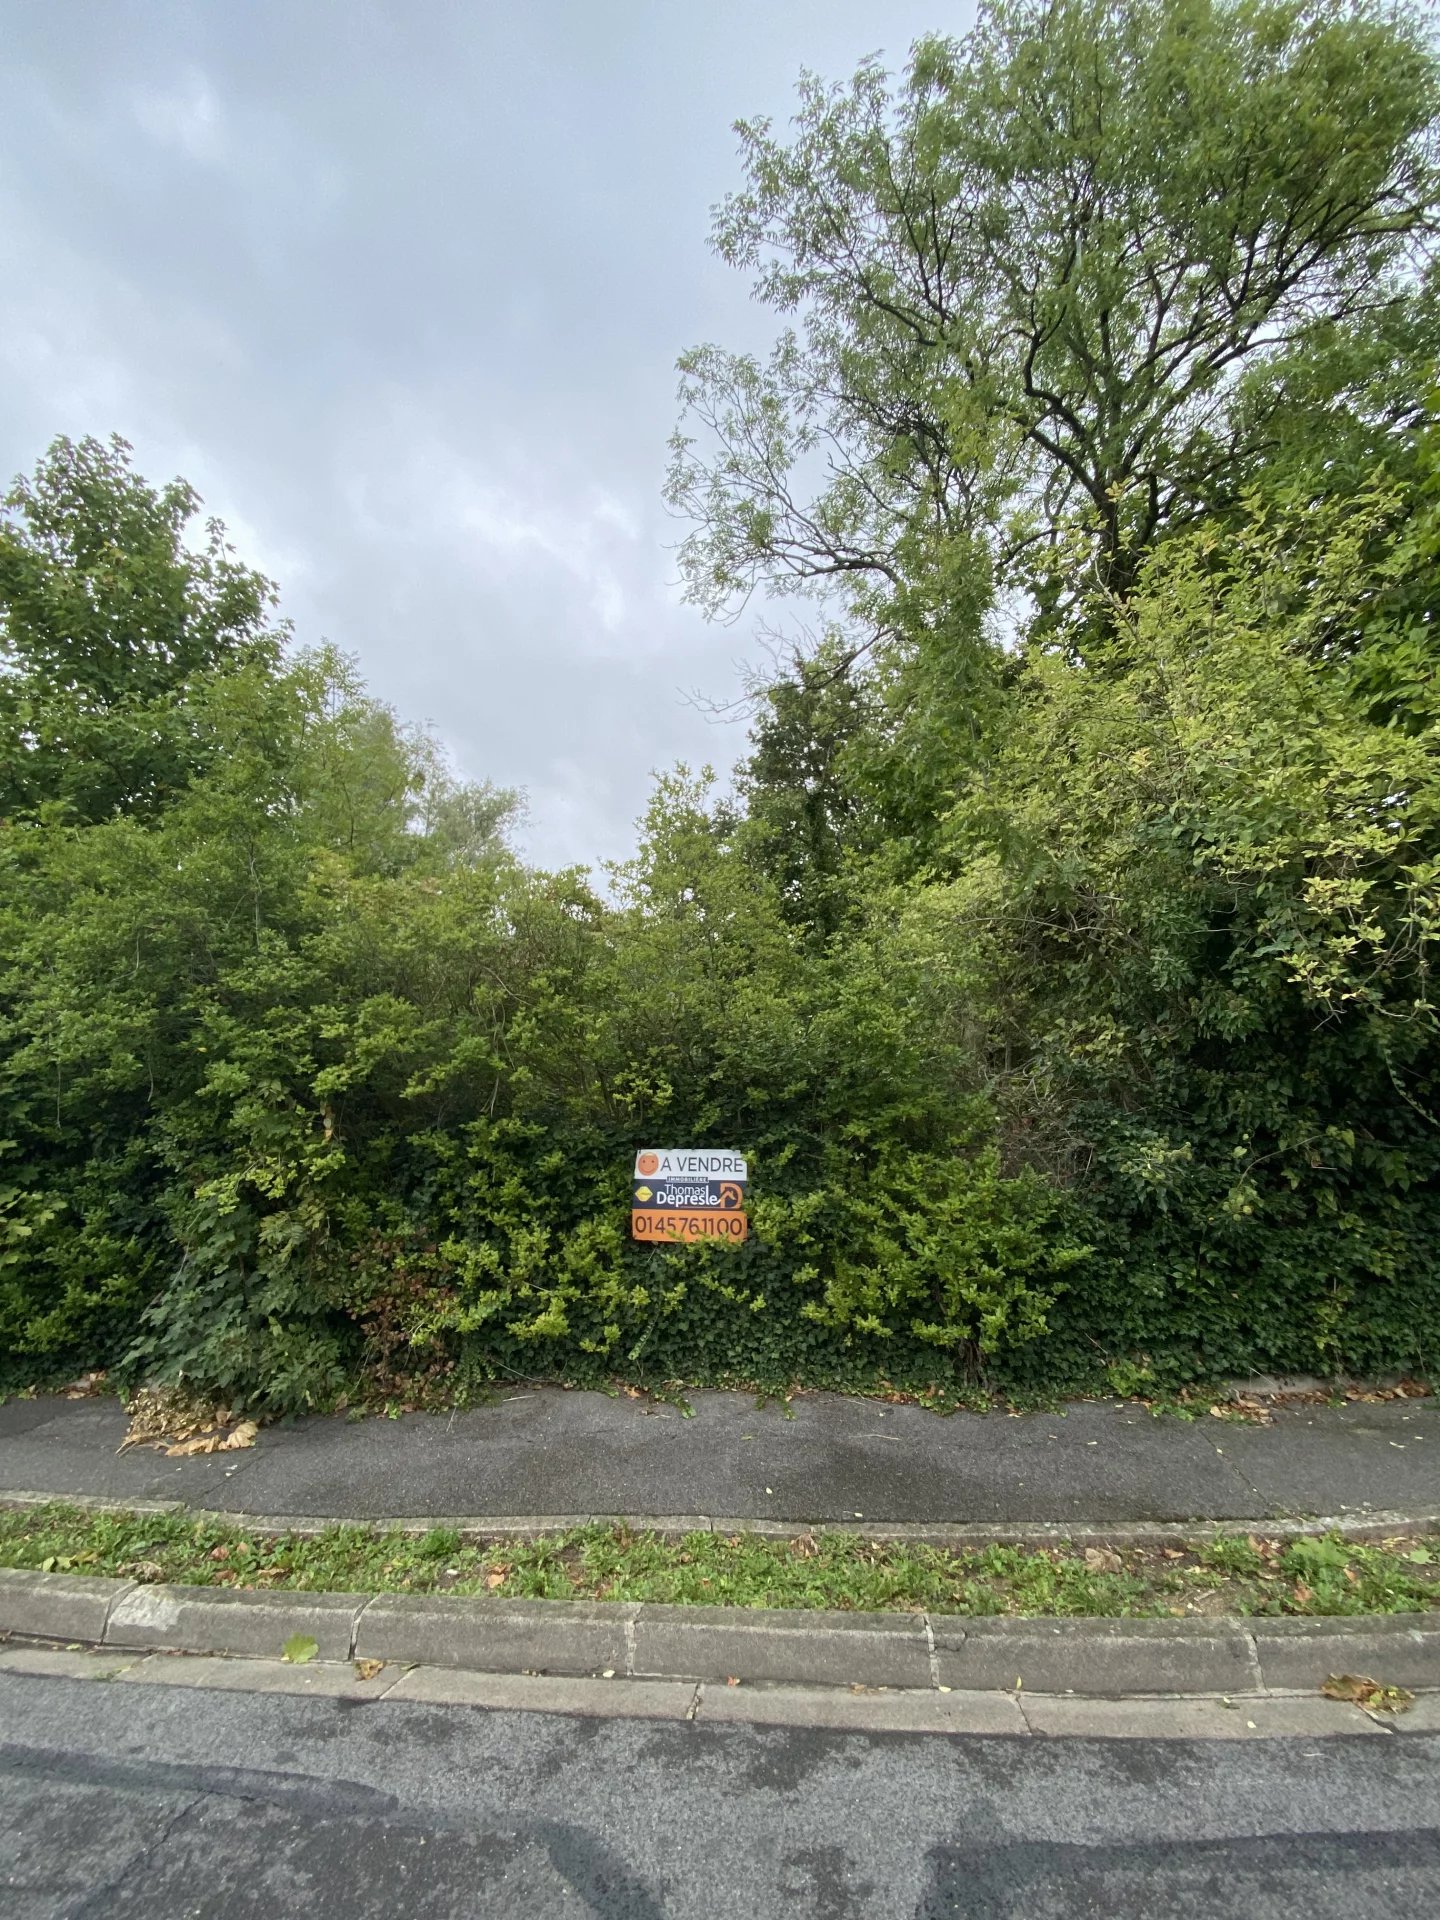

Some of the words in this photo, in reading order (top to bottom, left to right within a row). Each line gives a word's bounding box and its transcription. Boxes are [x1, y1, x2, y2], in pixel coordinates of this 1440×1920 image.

[660, 1157, 672, 1172] A
[676, 1157, 743, 1172] VENDRE
[656, 1185, 719, 1208] Depresle
[664, 1184, 705, 1195] Thomas
